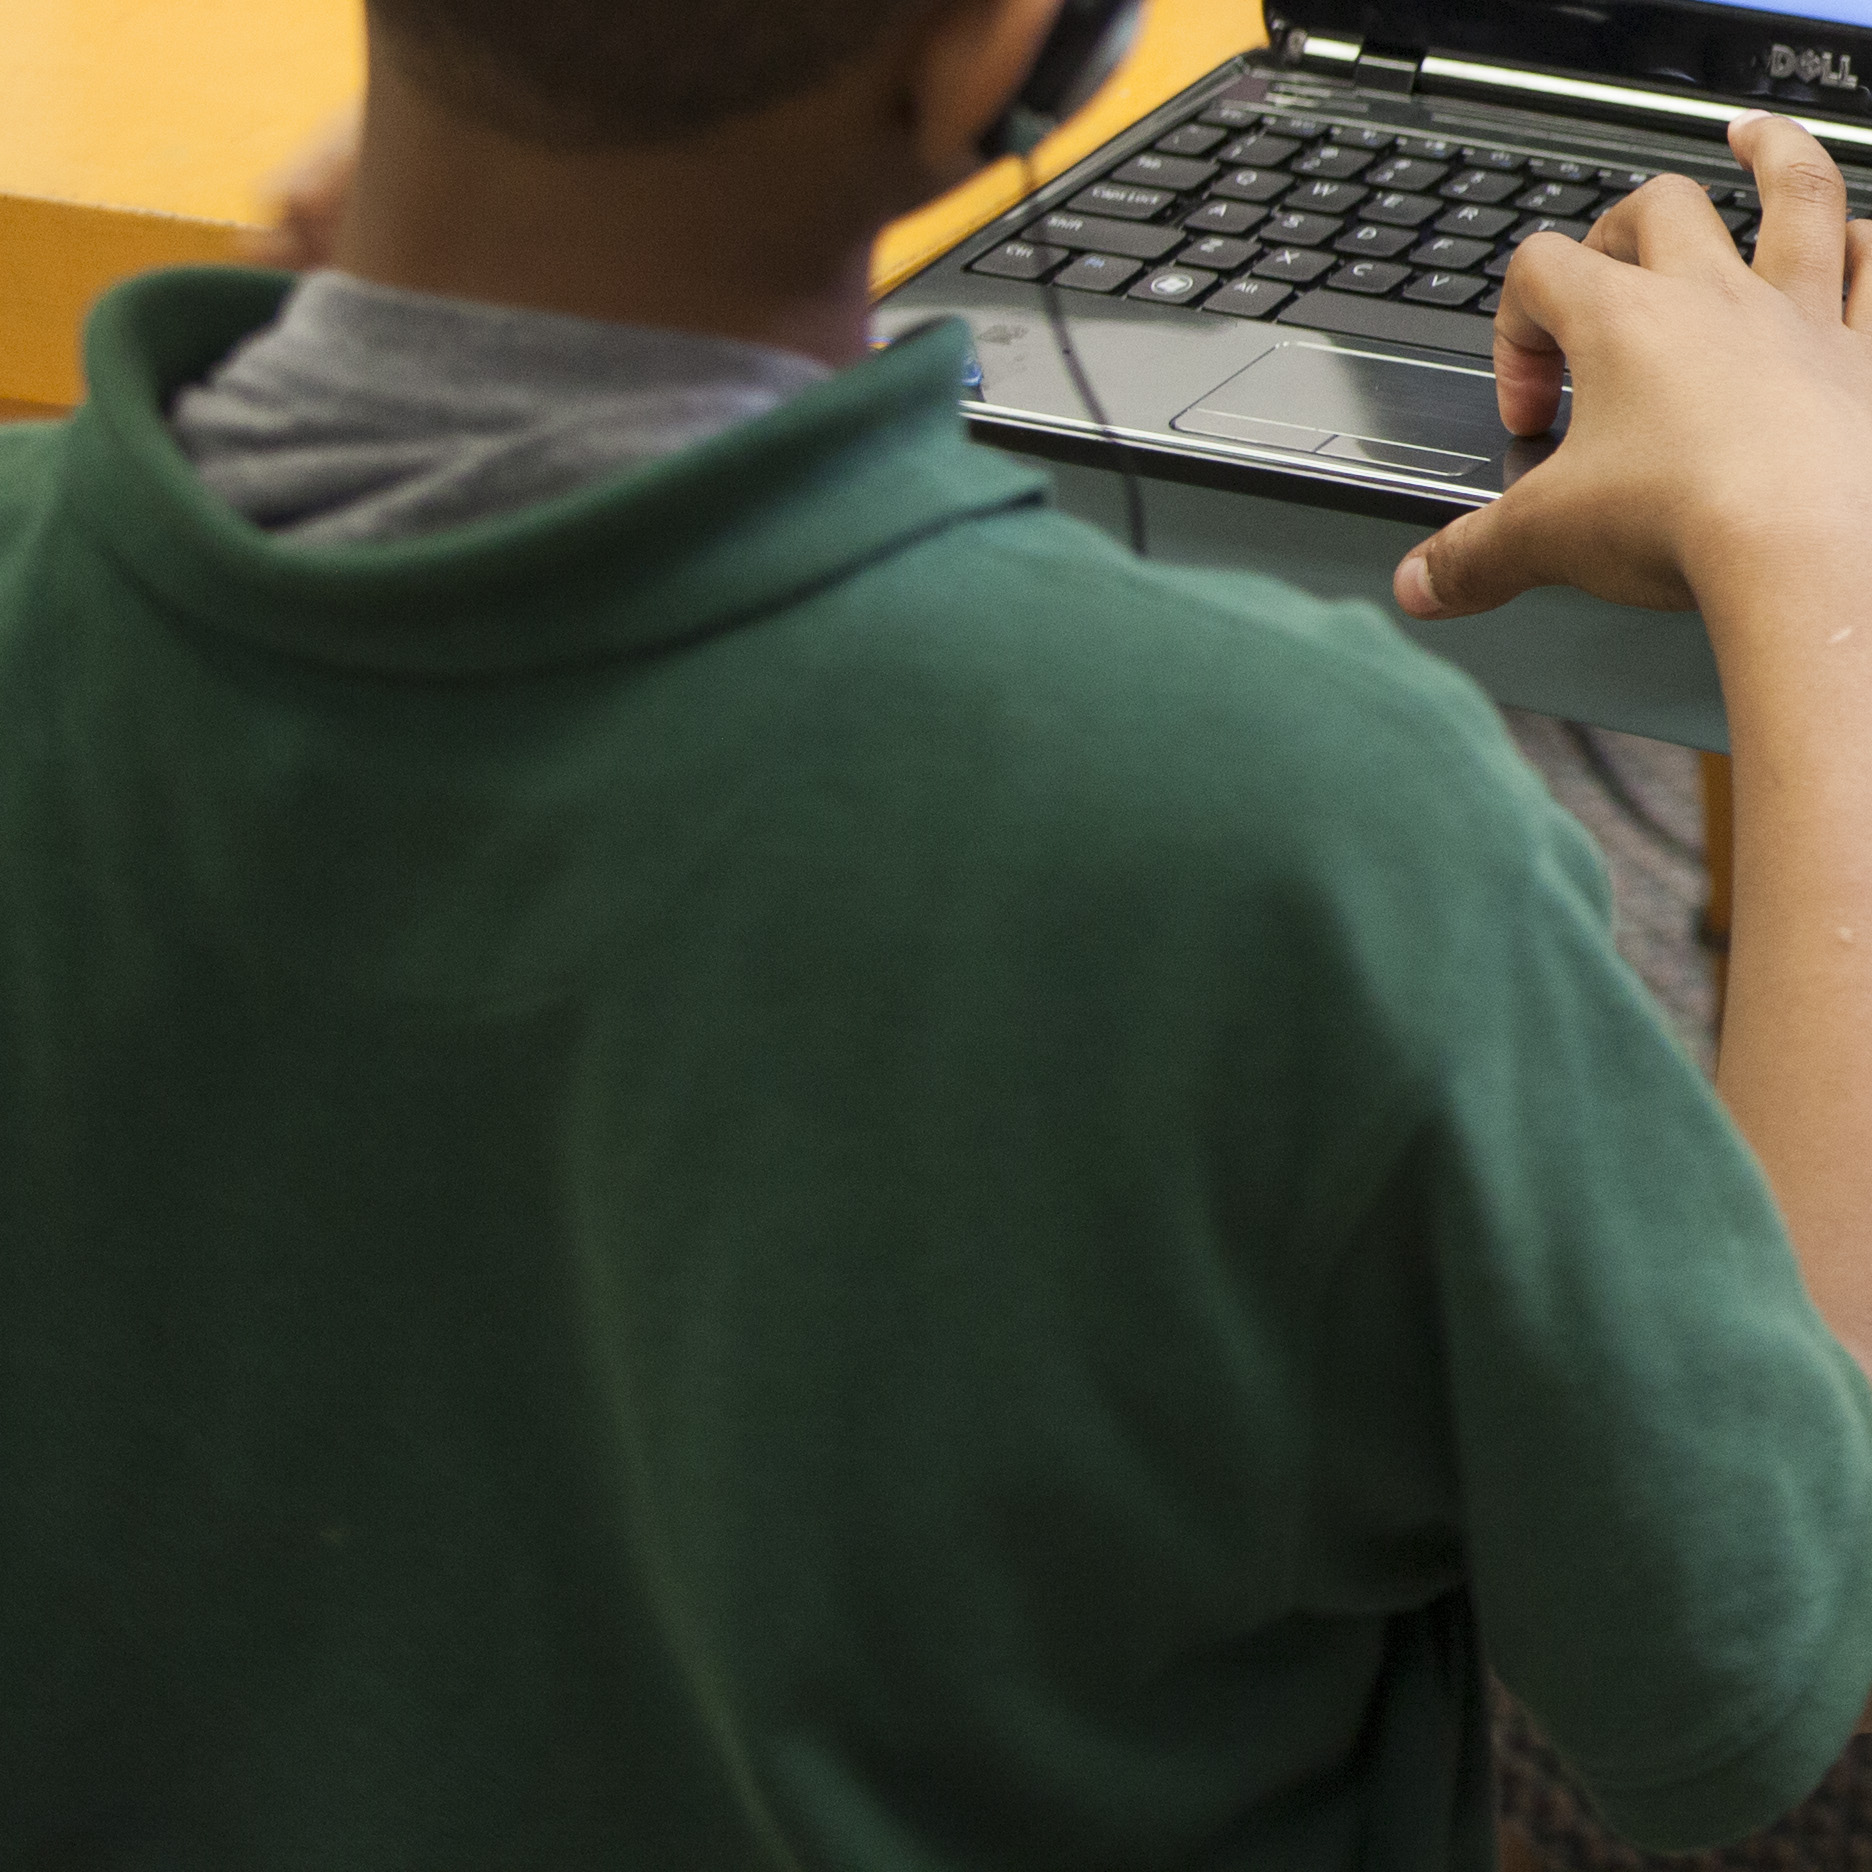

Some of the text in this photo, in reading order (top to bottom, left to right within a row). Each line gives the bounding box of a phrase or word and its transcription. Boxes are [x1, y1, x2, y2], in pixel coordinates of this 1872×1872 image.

[1312, 182, 1339, 196] W
[1276, 250, 1300, 265] X
[1353, 263, 1373, 276] C
[1431, 274, 1449, 287] V
